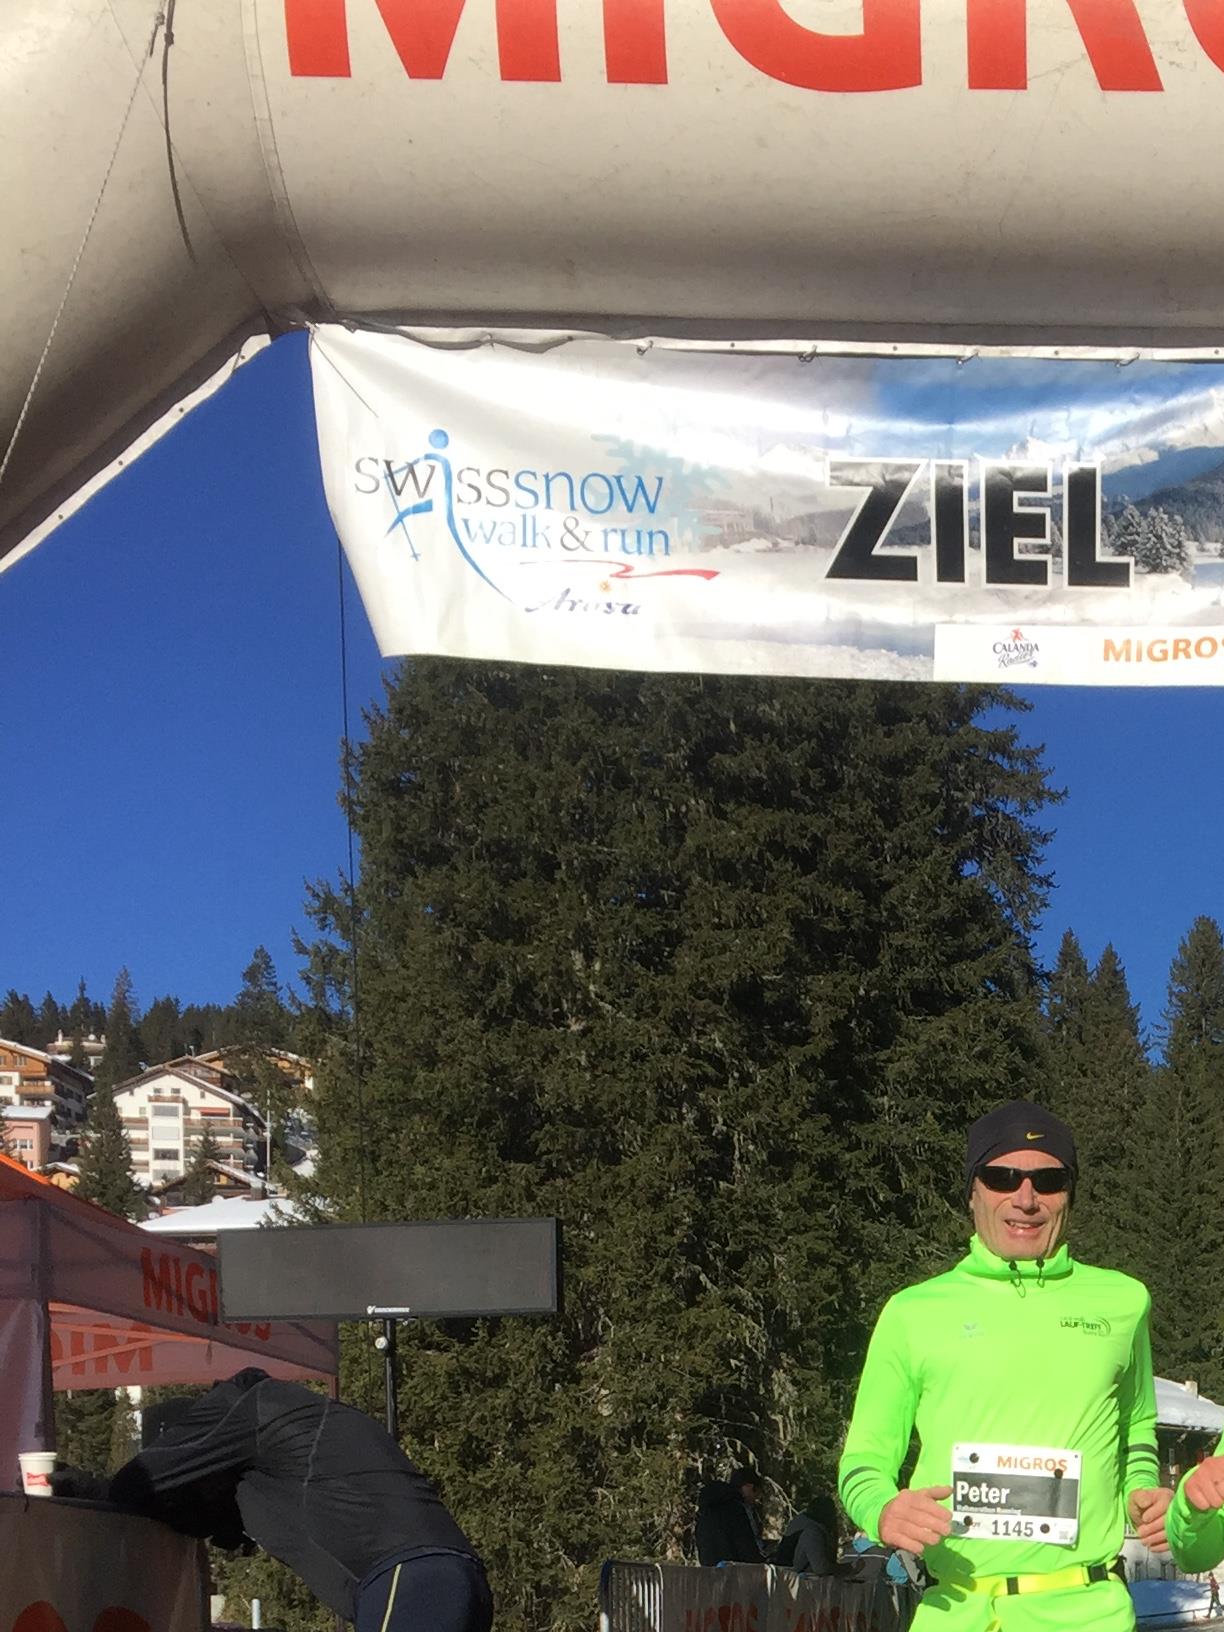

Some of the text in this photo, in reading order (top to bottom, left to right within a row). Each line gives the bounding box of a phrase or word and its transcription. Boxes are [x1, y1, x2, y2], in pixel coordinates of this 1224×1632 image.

[824, 458, 1134, 588] ZIEL
[461, 513, 671, 556] walk & run
[992, 641, 1039, 655] CALANDA
[996, 1455, 1068, 1474] MIGROS
[956, 1480, 1011, 1504] Peter
[991, 1519, 1034, 1538] 1145
